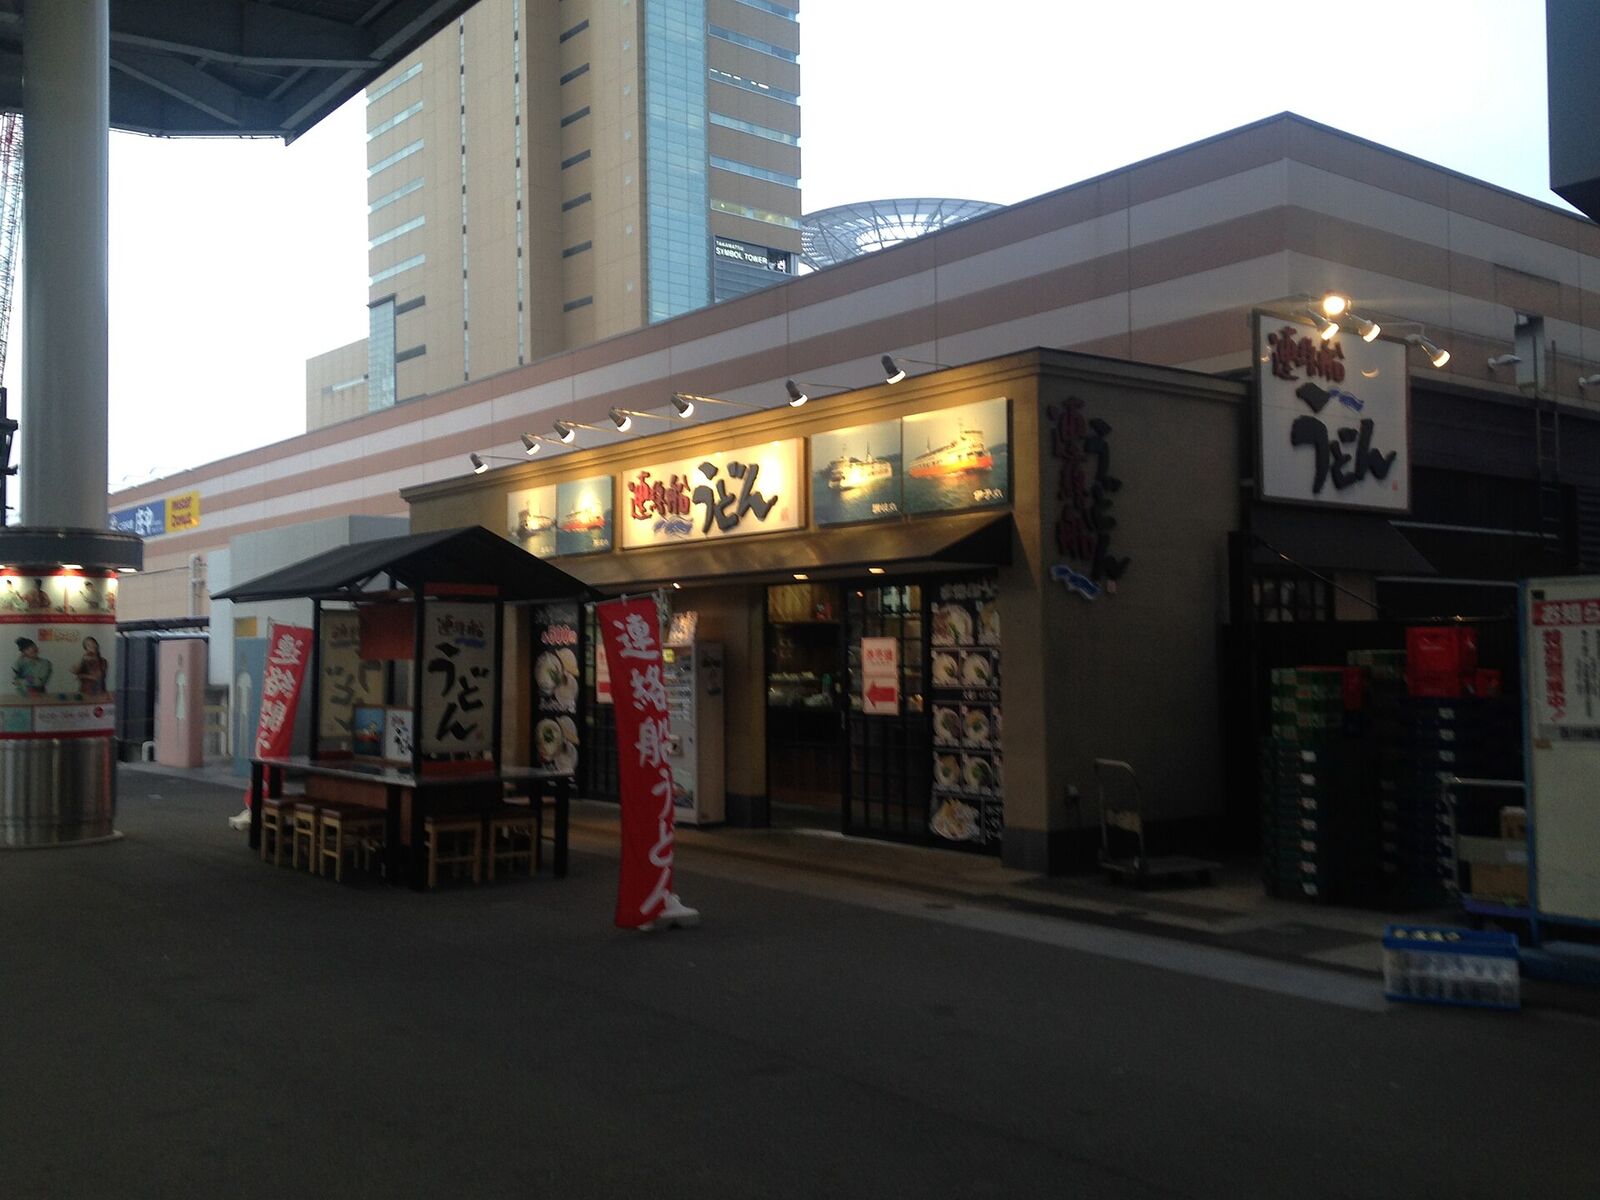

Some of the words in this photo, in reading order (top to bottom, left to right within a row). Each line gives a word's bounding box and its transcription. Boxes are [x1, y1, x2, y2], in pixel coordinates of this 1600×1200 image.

[715, 247, 743, 260] SYMBOL
[744, 253, 768, 265] TOWER
[1291, 382, 1397, 493] うどん
[692, 461, 779, 534] うどん
[427, 642, 489, 741] うどん
